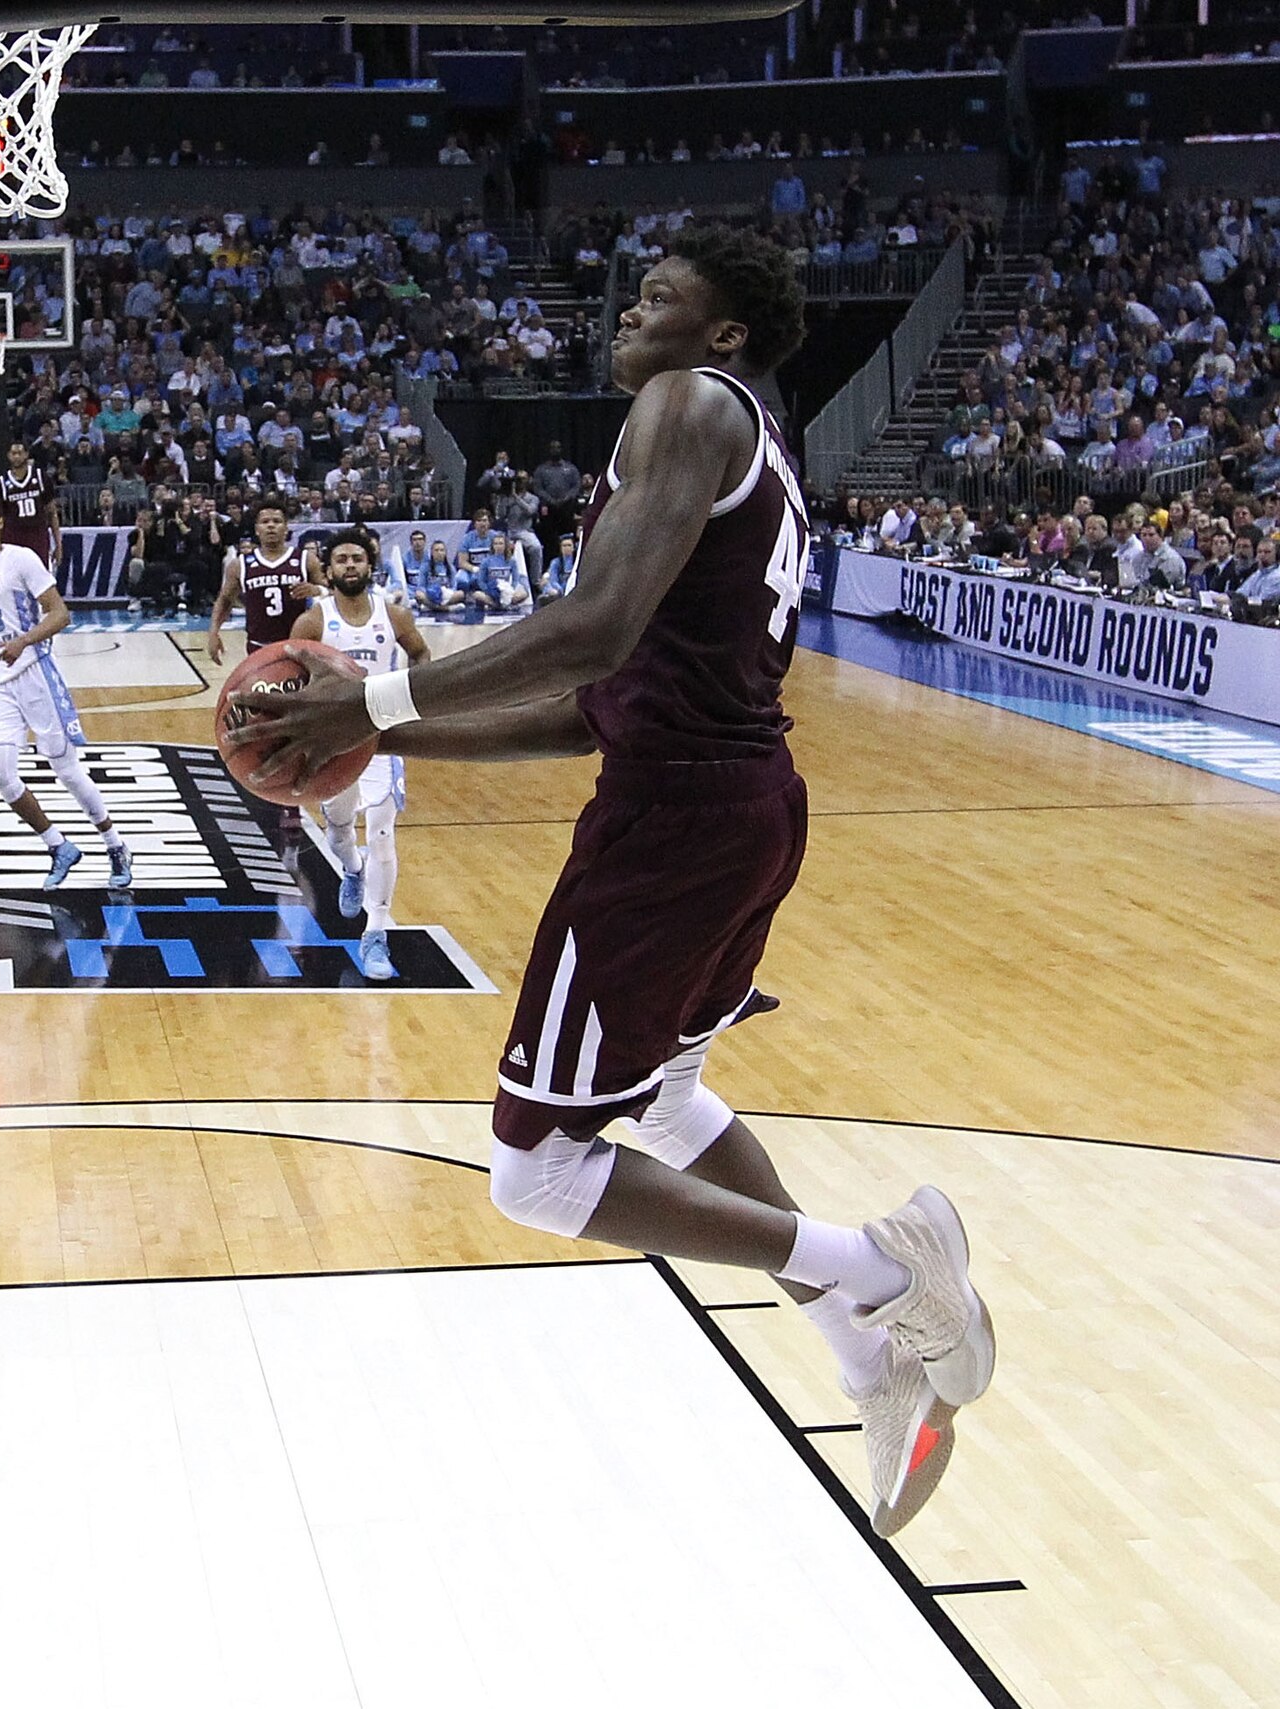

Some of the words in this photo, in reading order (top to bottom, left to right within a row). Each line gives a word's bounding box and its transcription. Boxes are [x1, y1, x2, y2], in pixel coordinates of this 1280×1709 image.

[17, 498, 36, 517] 10
[246, 575, 279, 589] TEXAS
[764, 496, 811, 644] 4
[264, 587, 283, 616] 3
[900, 566, 952, 632] FIRST
[954, 581, 996, 643] AND
[999, 588, 1095, 668] SECOND
[1097, 608, 1218, 697] ROUNDS
[340, 649, 377, 662] ORTH
